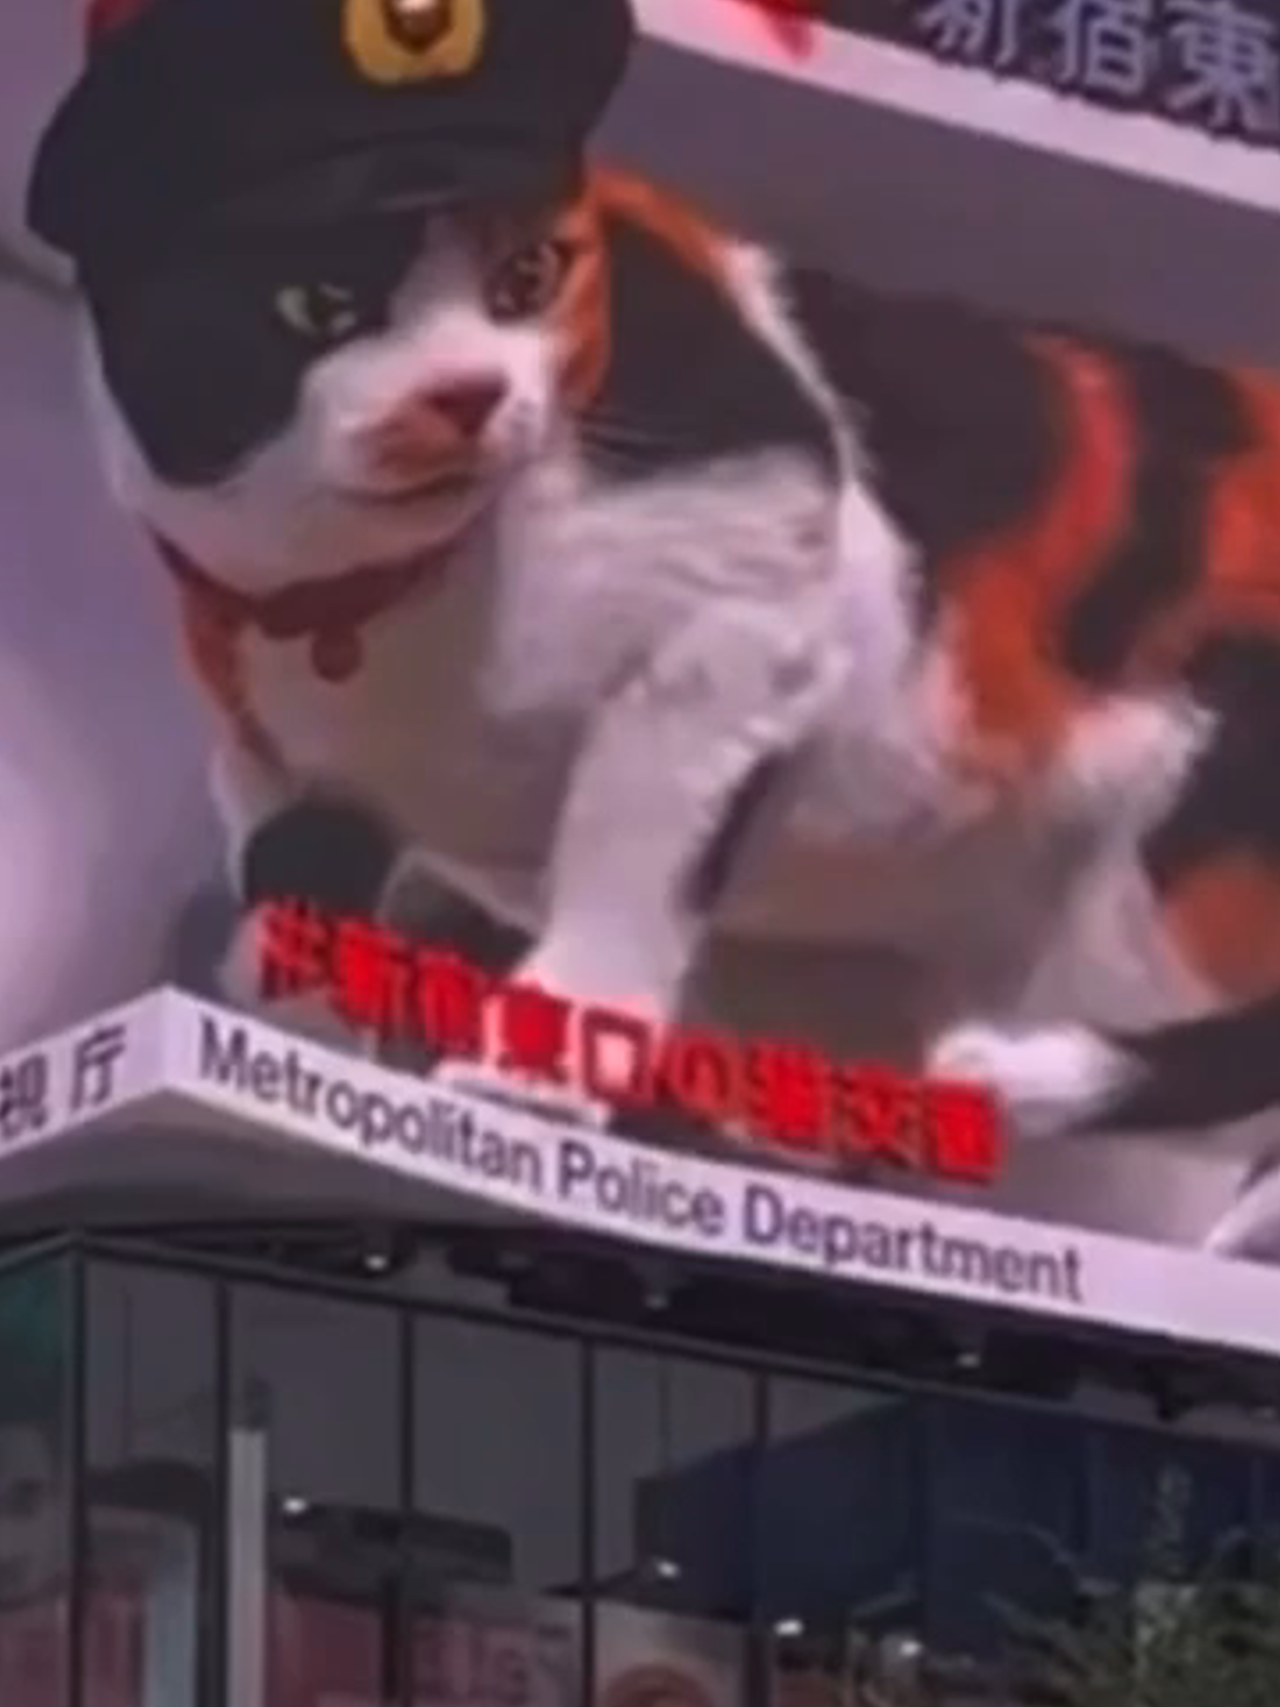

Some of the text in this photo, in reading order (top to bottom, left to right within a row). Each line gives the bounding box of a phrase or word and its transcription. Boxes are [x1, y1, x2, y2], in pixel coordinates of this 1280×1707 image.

[198, 1013, 1085, 1304] Metropolitan Police Department
